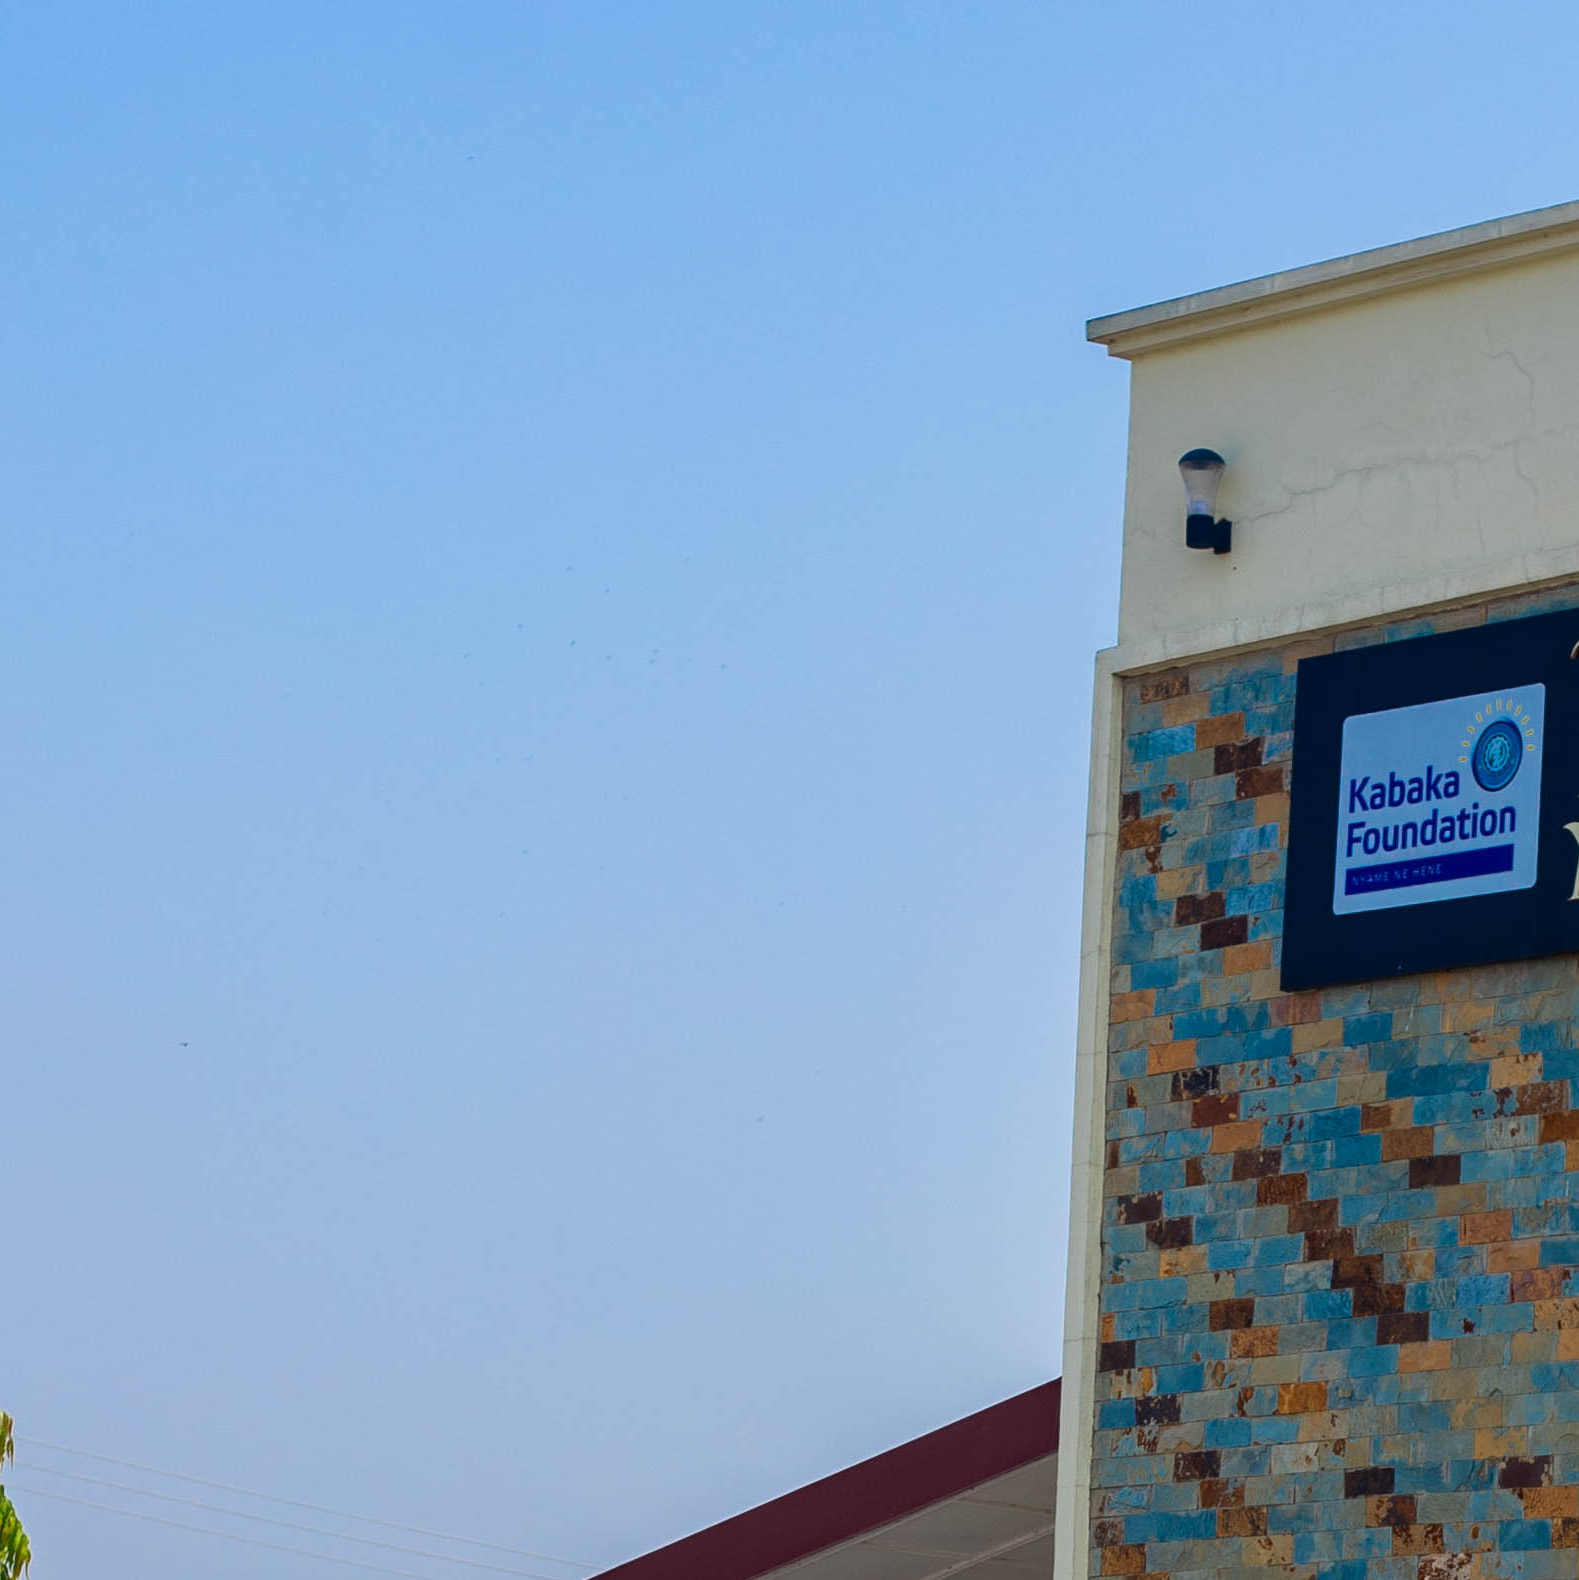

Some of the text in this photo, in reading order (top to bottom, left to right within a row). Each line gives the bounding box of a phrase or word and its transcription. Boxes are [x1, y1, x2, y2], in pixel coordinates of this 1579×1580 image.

[1348, 765, 1460, 813] Kabaka
[1346, 802, 1516, 858] Foundation
[1394, 868, 1408, 881] NE
[1413, 863, 1442, 877] HENE
